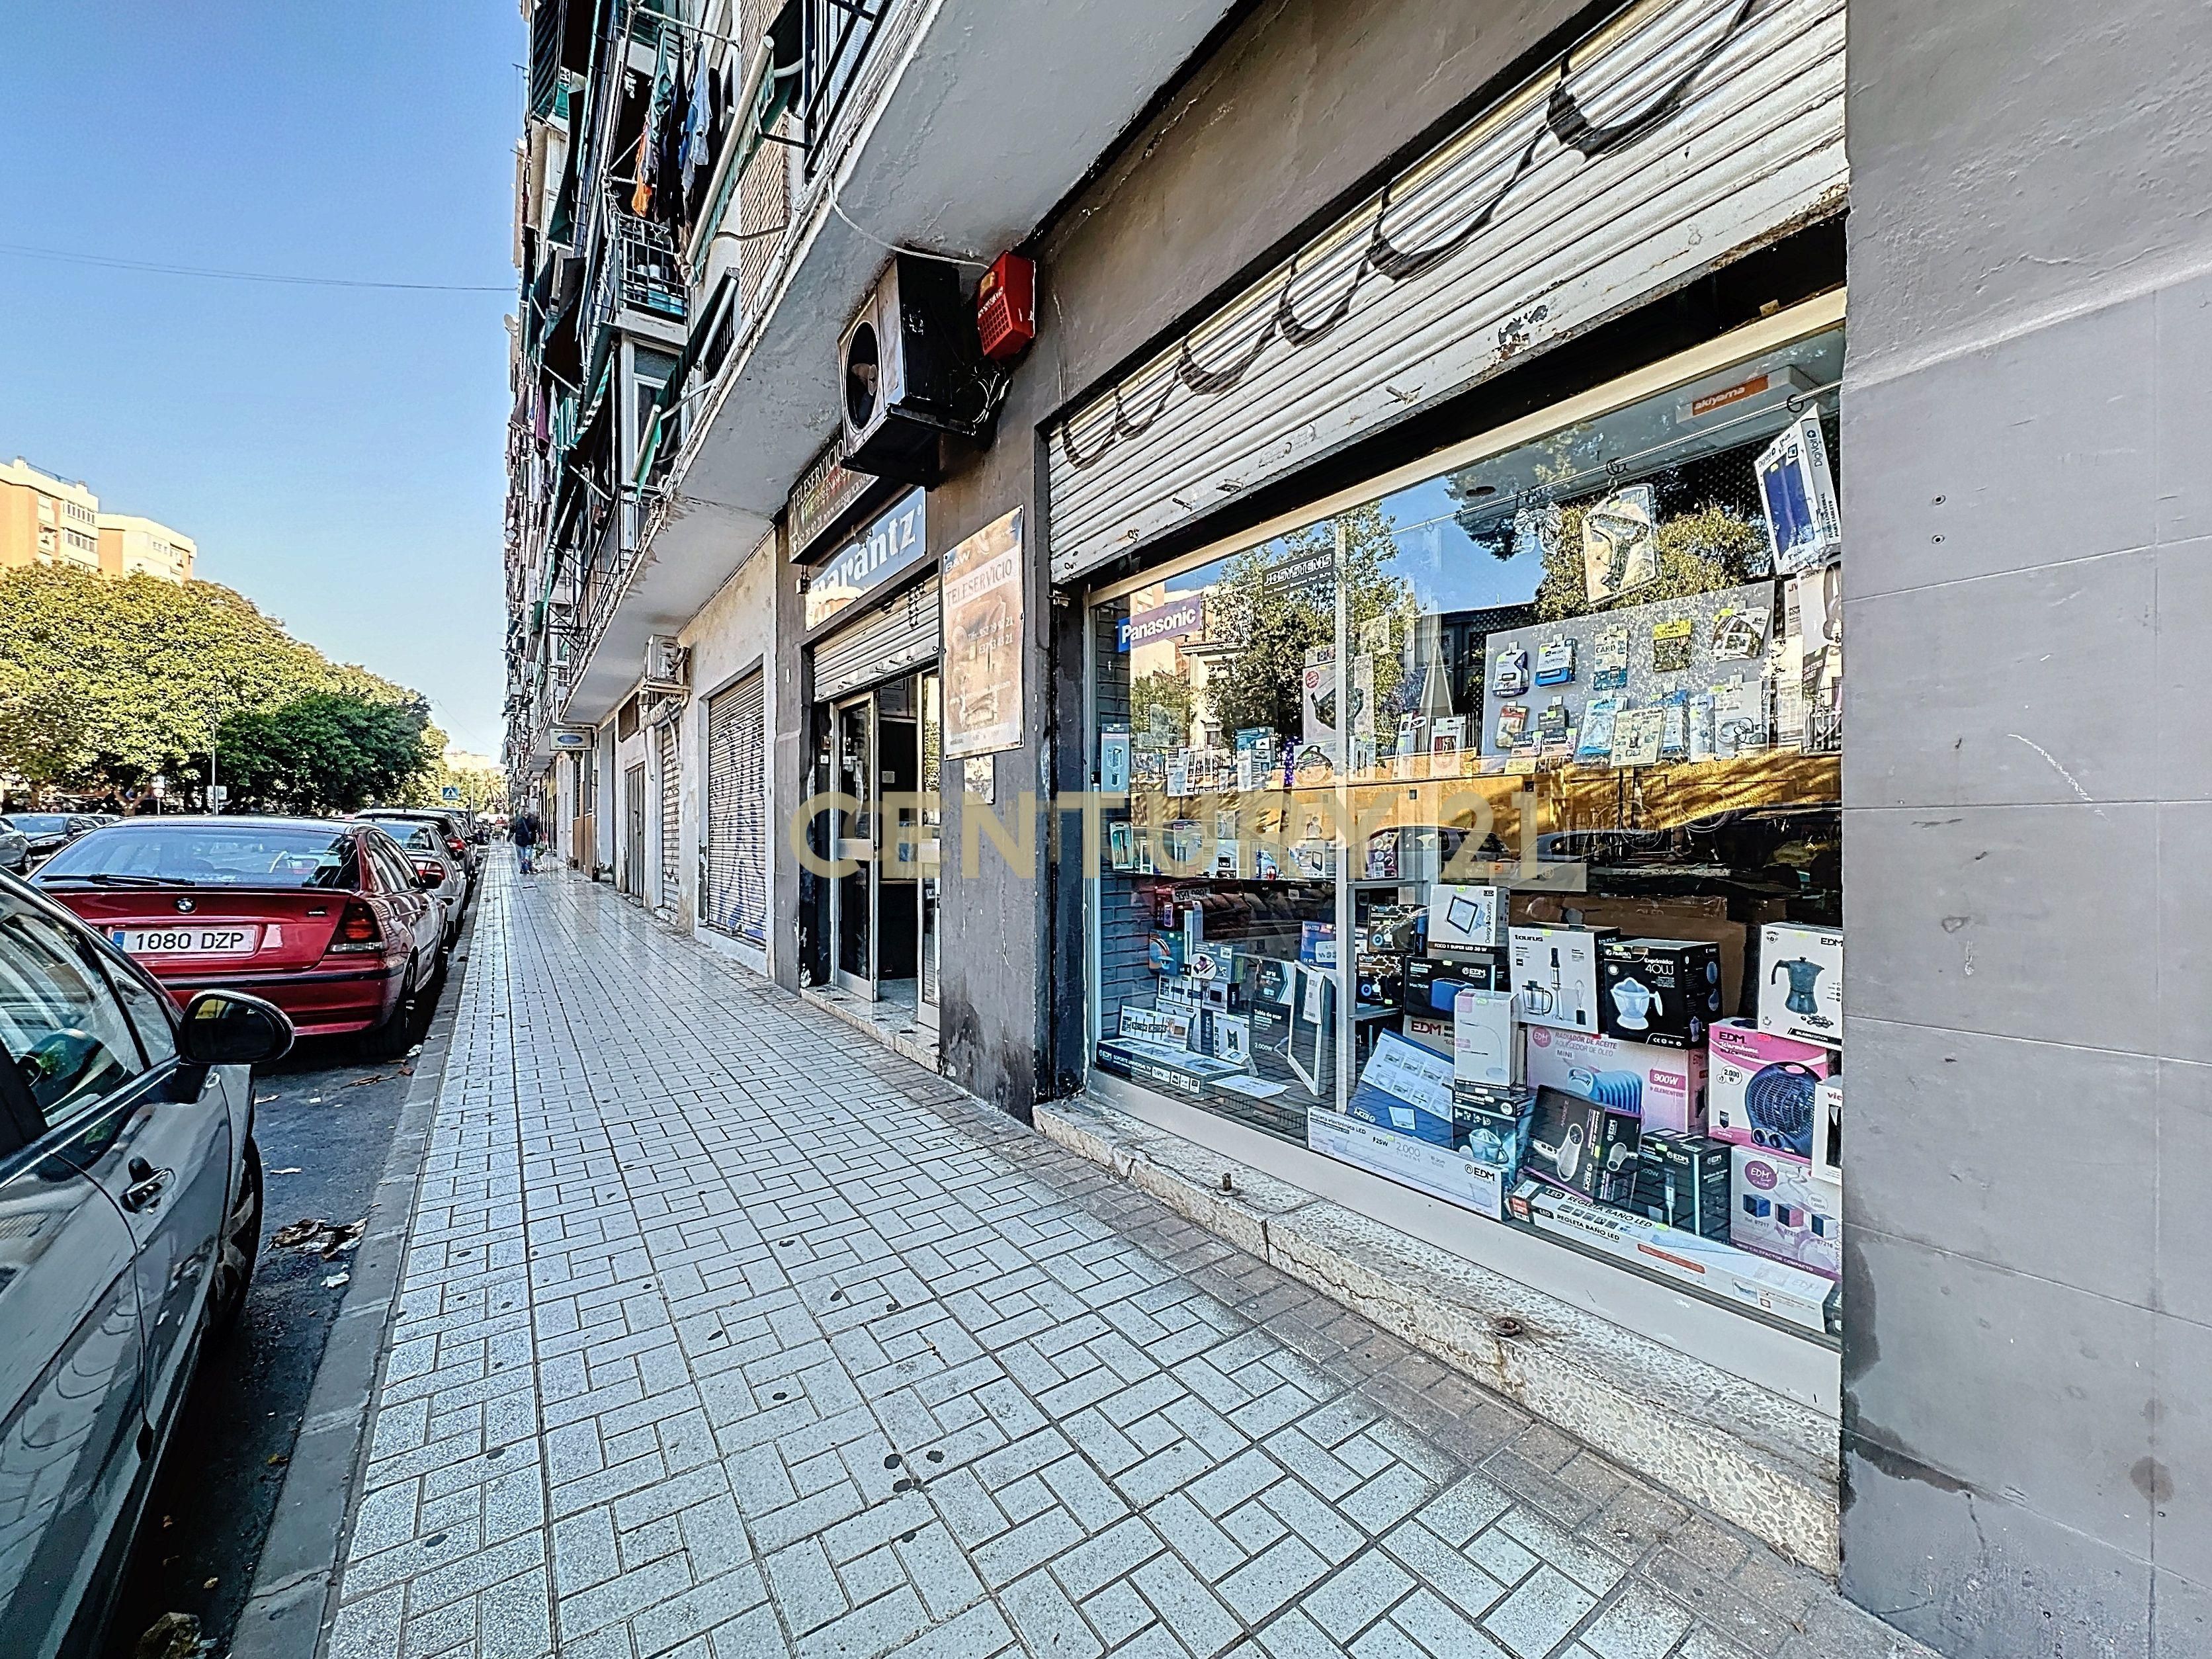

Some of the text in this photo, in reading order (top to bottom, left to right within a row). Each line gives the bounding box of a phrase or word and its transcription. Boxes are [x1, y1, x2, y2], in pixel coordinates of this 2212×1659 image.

[1694, 386, 1746, 410] akiyama
[792, 439, 844, 511] TELESERVICIO
[945, 549, 971, 574] B&W
[1800, 570, 1820, 581] SONY
[945, 558, 1013, 607] TELESERVICIO
[1005, 615, 1014, 628] 21
[1121, 605, 1197, 644] Panasonic
[1005, 633, 1013, 647] 21
[1595, 644, 1616, 654] CARD
[136, 932, 245, 951] 1080 DZP
[1820, 937, 1844, 947] EDM
[1644, 964, 1674, 975] 40W
[1411, 1020, 1441, 1036] EDM
[1533, 1031, 1549, 1042] EDM
[1555, 1032, 1617, 1049] RADIADOR DE ACEITE
[1719, 1031, 1746, 1044] EDM
[1554, 1040, 1588, 1051] AQUECEDOR
[1556, 1050, 1572, 1058] MINI
[1653, 1073, 1679, 1085] 900W
[1724, 1069, 1740, 1078] 2.000
[1355, 1127, 1367, 1135] LED
[1375, 1138, 1388, 1148] 25W
[1396, 1142, 1421, 1157] 2.000
[1673, 1153, 1689, 1164] EDM
[1473, 1168, 1496, 1182] EDM
[1750, 1168, 1771, 1179] EDM
[1546, 1189, 1562, 1199] LED
[1567, 1196, 1653, 1228] REGLETA BAÑO LED
[1556, 1213, 1620, 1241] REGLETA BAÑO LED
[1783, 1257, 1814, 1273] COMPACTO
